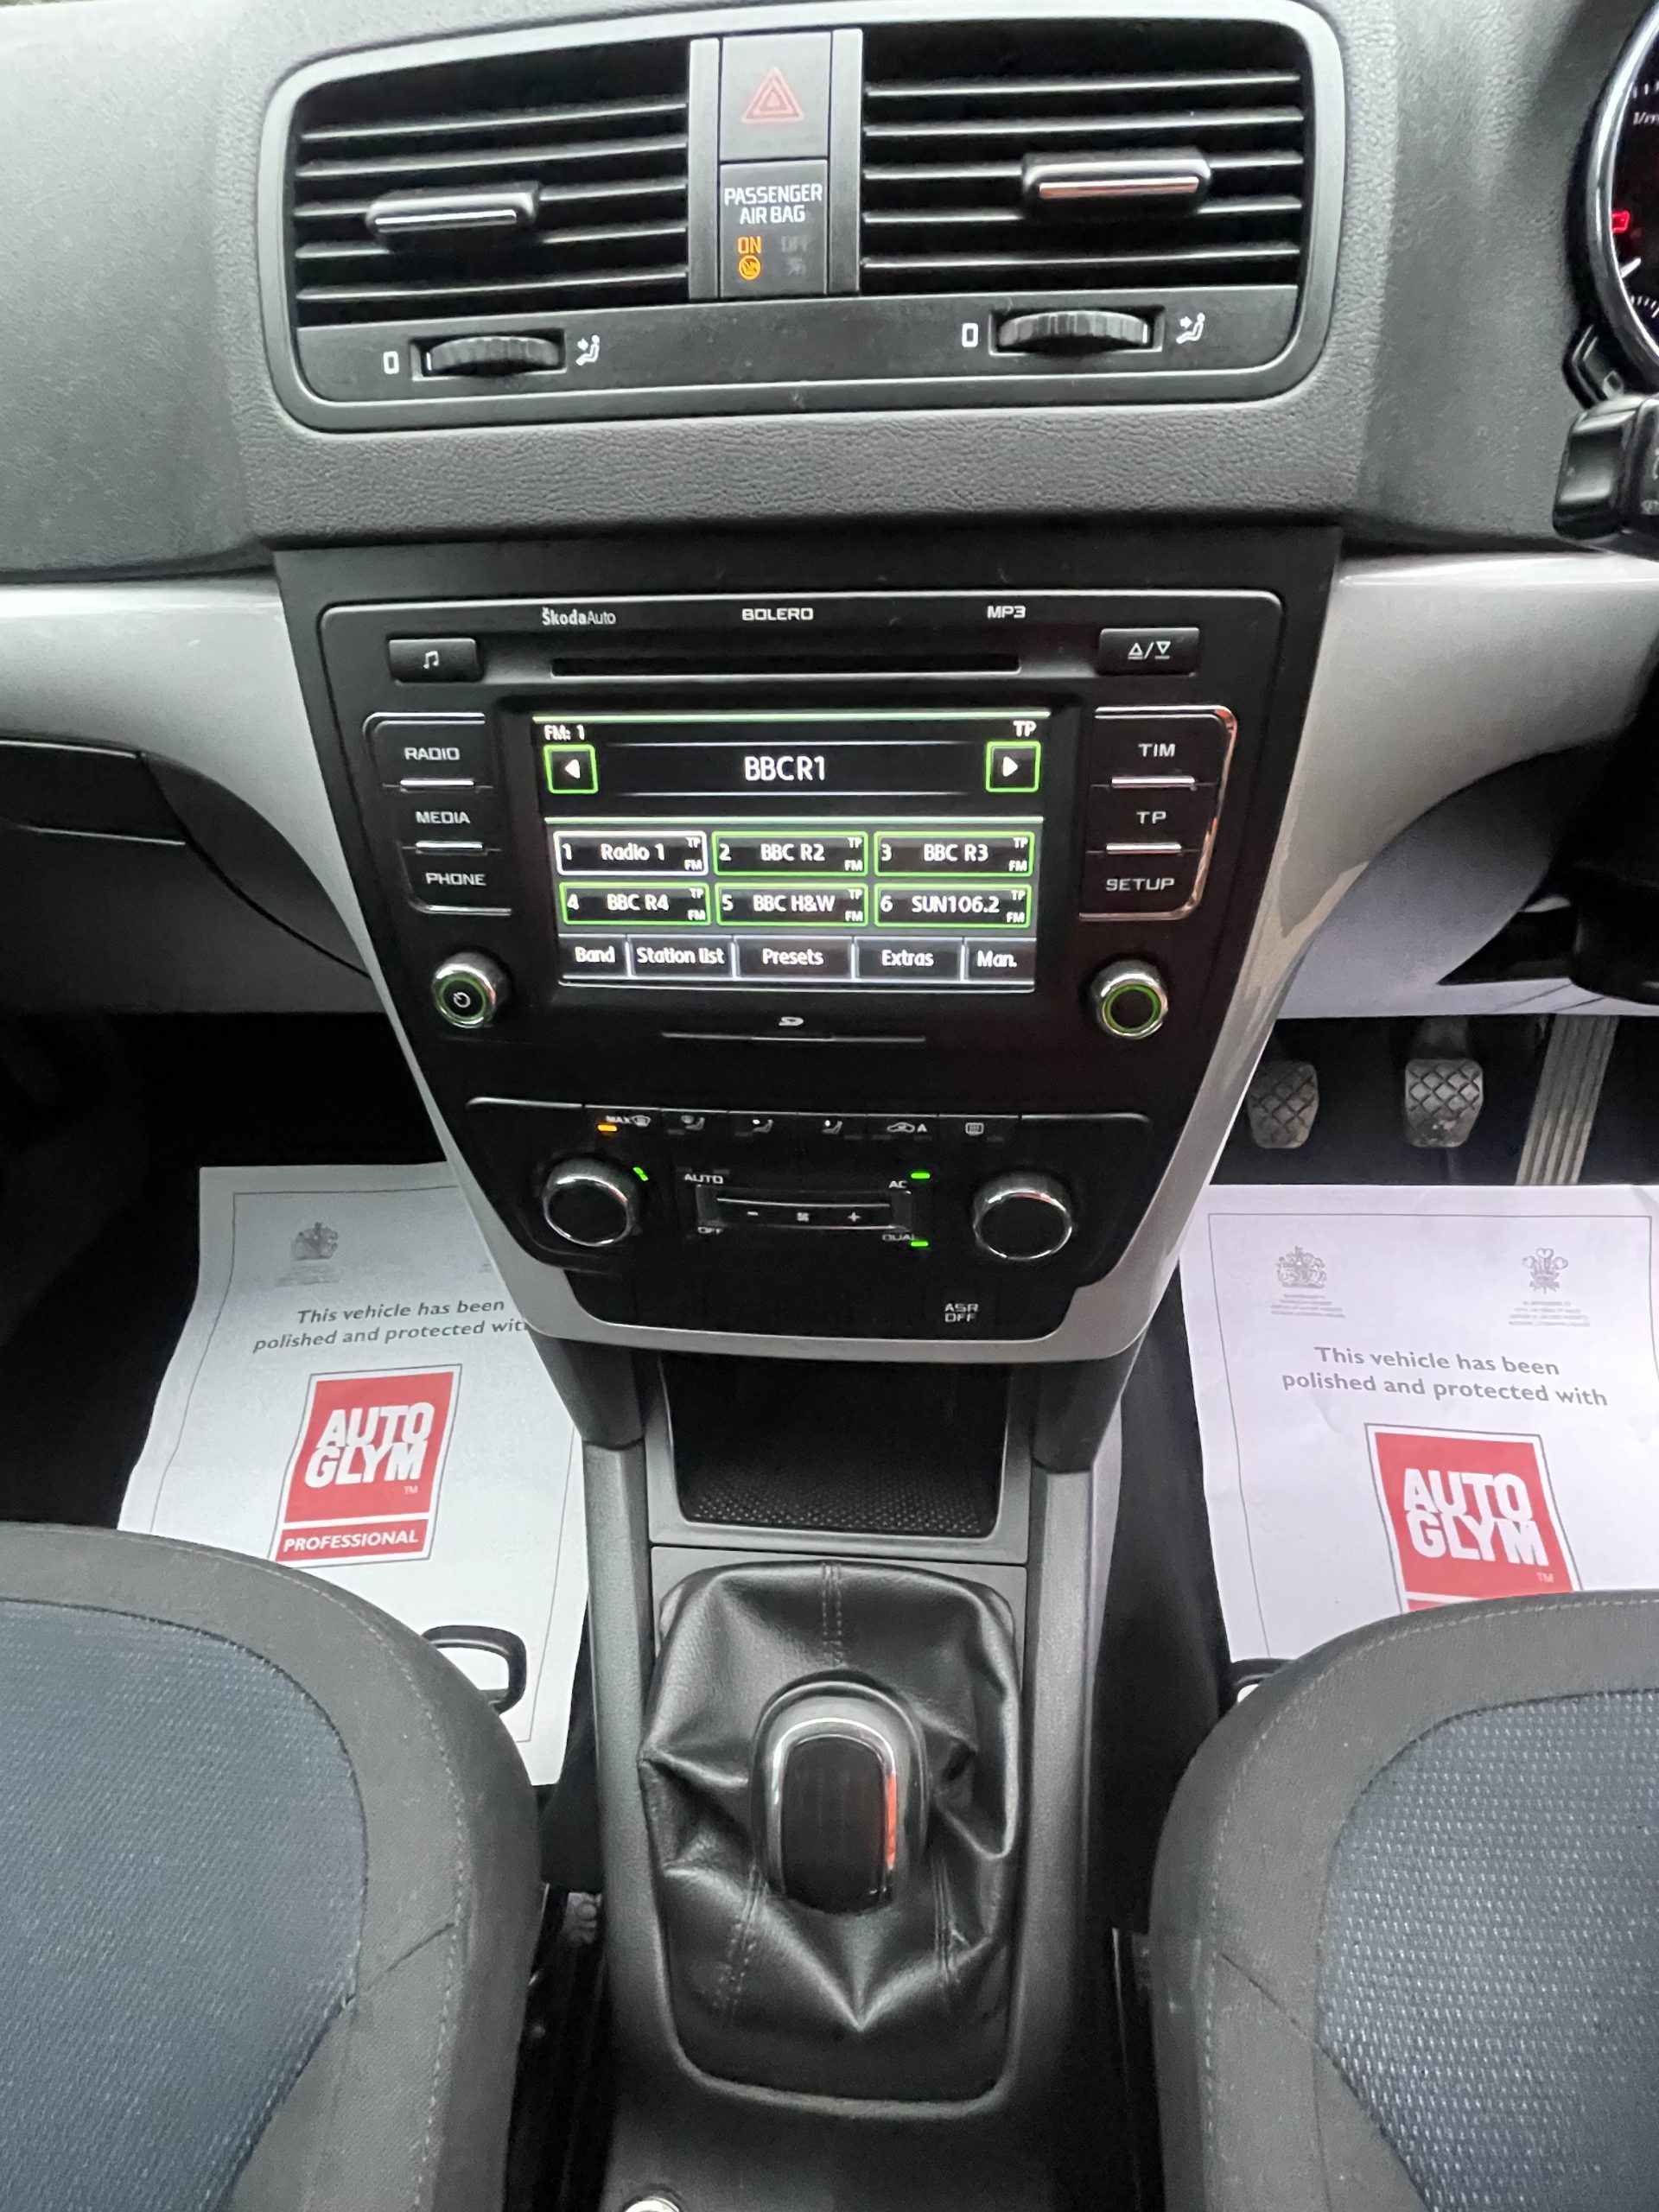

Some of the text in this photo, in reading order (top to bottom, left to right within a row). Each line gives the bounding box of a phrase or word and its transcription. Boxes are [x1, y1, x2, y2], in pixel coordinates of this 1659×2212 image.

[724, 183, 823, 206] PASSENGER
[740, 205, 805, 225] AIR BAG
[737, 236, 761, 254] ON
[741, 607, 814, 621] BOLERO
[987, 605, 1027, 619] MP3
[544, 725, 586, 741] FM: 1
[1014, 721, 1036, 736] TP
[404, 747, 460, 760] RADIO
[1138, 743, 1176, 757] TIM
[416, 810, 470, 824] MEDIA
[1136, 810, 1166, 824] TP
[686, 836, 701, 849] TP
[848, 836, 862, 849] TP
[1014, 837, 1028, 849] TP
[563, 843, 664, 861] 1 Radio 1
[719, 843, 825, 861] 2 BBC R2
[880, 844, 988, 861] 3 BBC R3
[684, 859, 702, 871] FM
[844, 860, 862, 872] FM
[1008, 860, 1027, 872] FM
[425, 873, 486, 887] PHONE
[1106, 878, 1174, 892] SETUP
[690, 887, 703, 899] TP
[848, 888, 862, 899] TP
[1011, 890, 1026, 901] TP
[566, 893, 670, 911] 4 BBC R4
[721, 894, 836, 912] 5 BBC H&W
[880, 896, 893, 912] 6
[688, 910, 706, 921] FM
[844, 911, 863, 922] FM
[1006, 912, 1025, 924] FM
[575, 947, 616, 963] Band
[636, 947, 725, 964] Station list
[761, 948, 824, 966] Presets
[881, 950, 934, 967] Extras
[976, 950, 1017, 968] Man.
[684, 1173, 724, 1184] AUTO
[297, 1300, 505, 1325] This vehicle has been
[944, 1303, 979, 1313] ASR
[944, 1313, 976, 1323] OFF
[252, 1318, 527, 1354] polished and protected wit
[1314, 1346, 1560, 1376] This vehicle has been
[1282, 1372, 1608, 1407] polished and protected with
[316, 1402, 435, 1449] AUTO
[304, 1440, 428, 1489] GLYM
[1403, 1468, 1533, 1522] AUTO
[283, 1529, 419, 1553] PROFESSIONAL
[1406, 1510, 1549, 1567] GLYM
